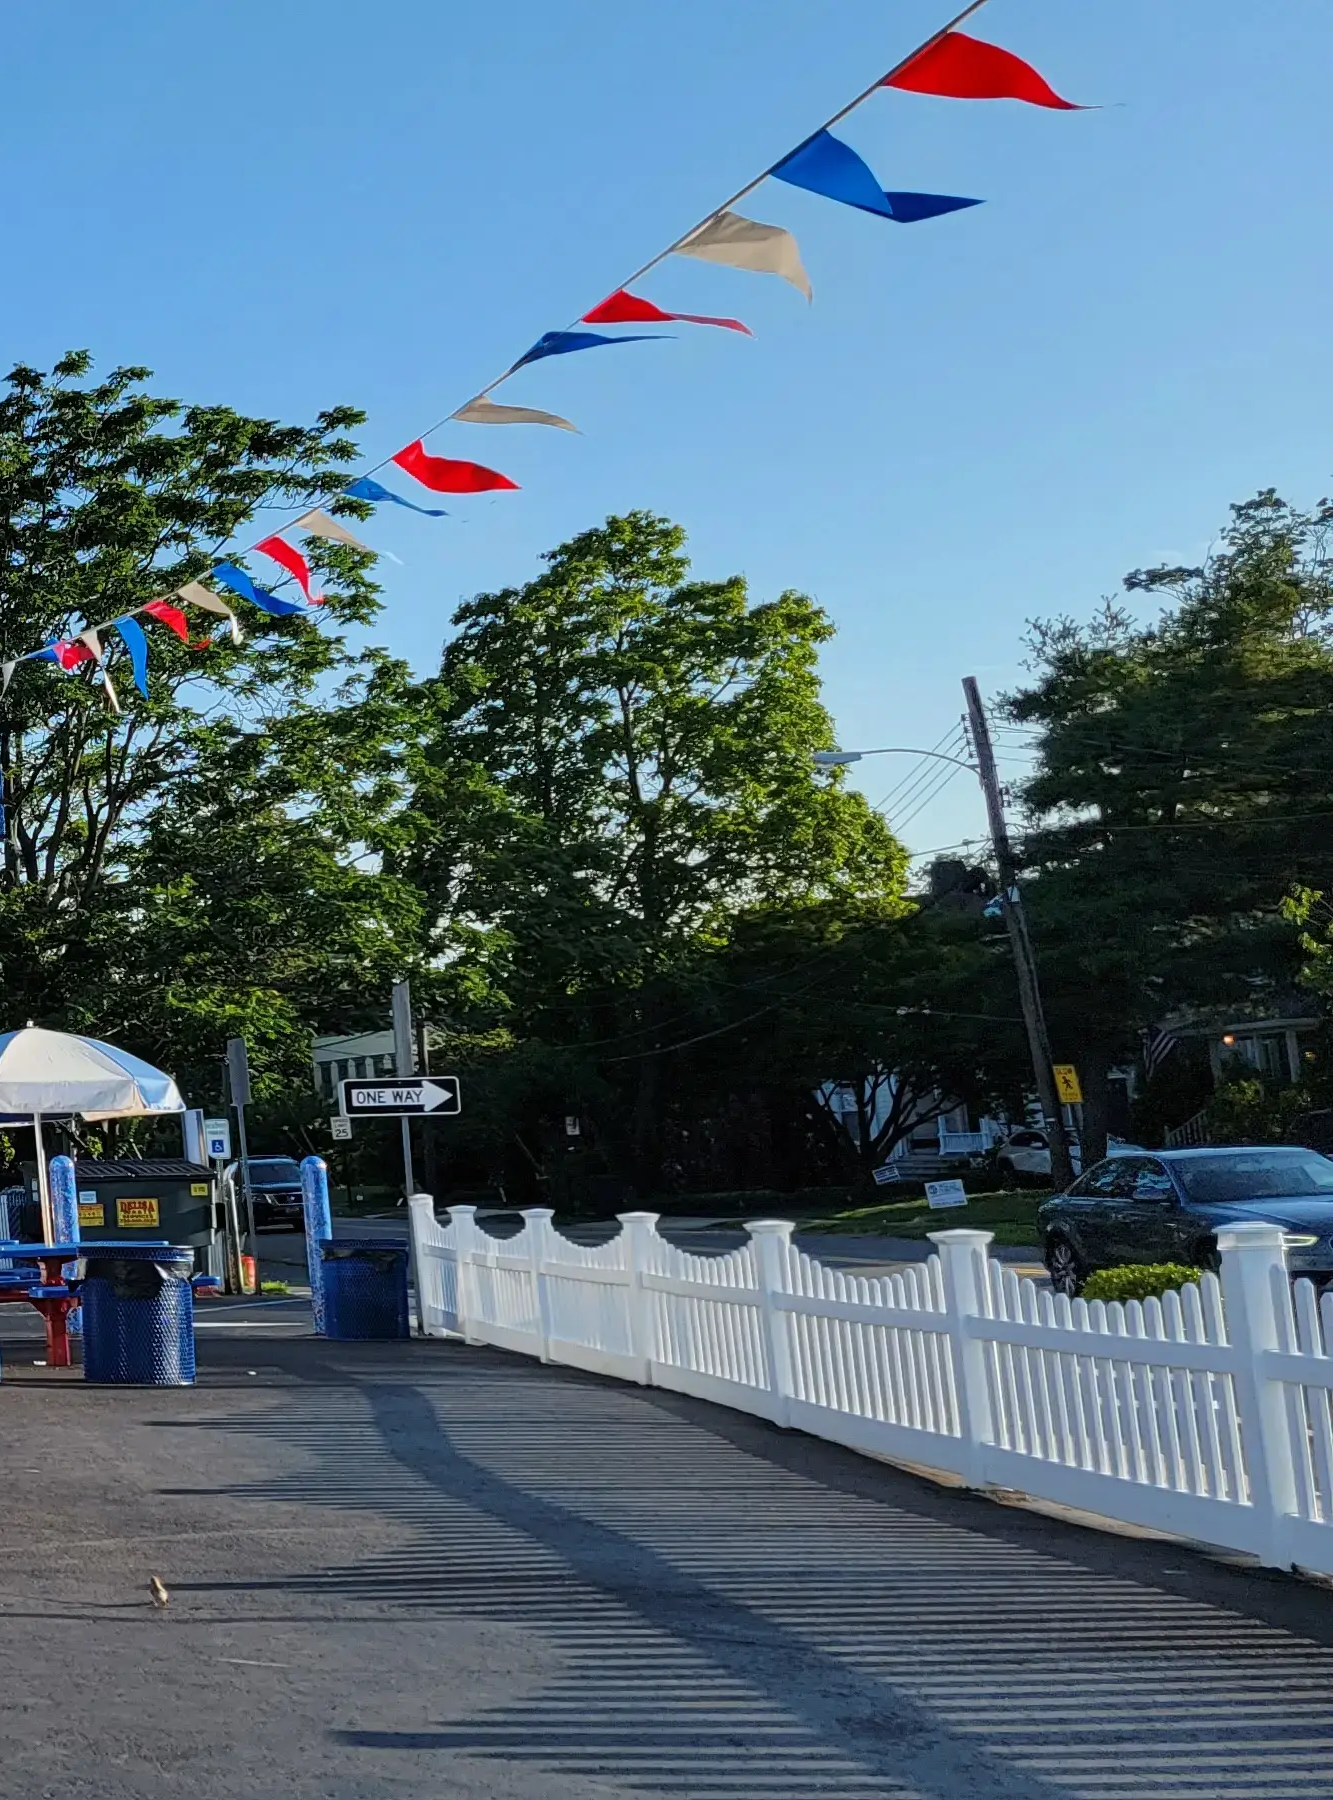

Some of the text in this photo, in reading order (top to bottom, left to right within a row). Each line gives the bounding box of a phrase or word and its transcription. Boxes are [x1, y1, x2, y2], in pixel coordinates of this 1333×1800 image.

[356, 1090, 423, 1104] ONE WAY
[334, 1128, 349, 1138] 25
[120, 1200, 156, 1212] DELISA
